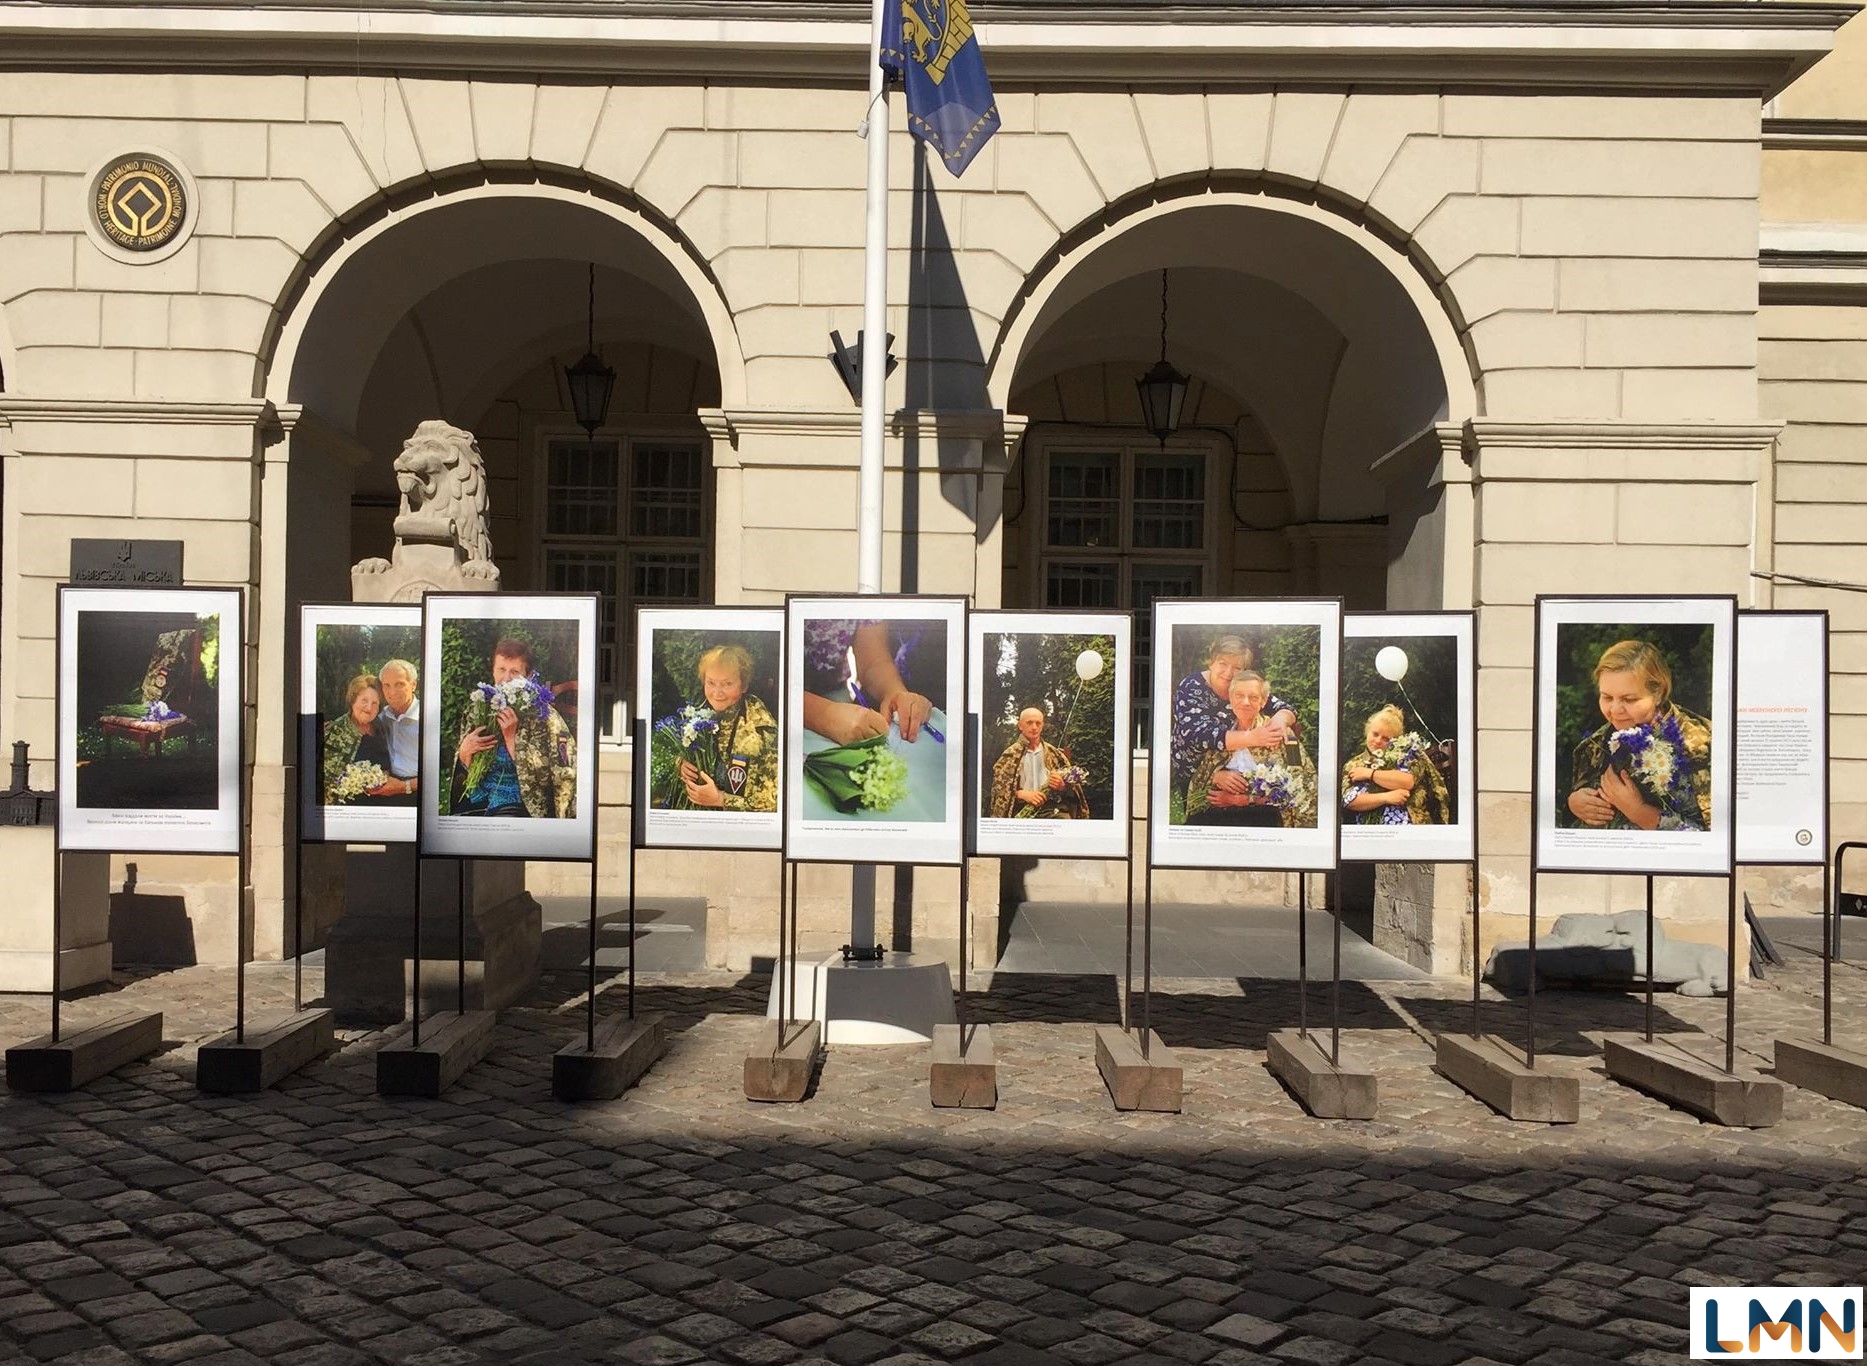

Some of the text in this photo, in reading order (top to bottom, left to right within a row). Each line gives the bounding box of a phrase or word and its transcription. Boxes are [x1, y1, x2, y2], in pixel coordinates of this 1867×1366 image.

[101, 160, 173, 191] PATRIMONIO MUNDIAL
[98, 193, 135, 245] WORLD HERITAGE
[138, 184, 182, 245] PATRIMOINE MONDIAL
[75, 568, 174, 582] ЛЬВІВСЬКА МІСЬКА
